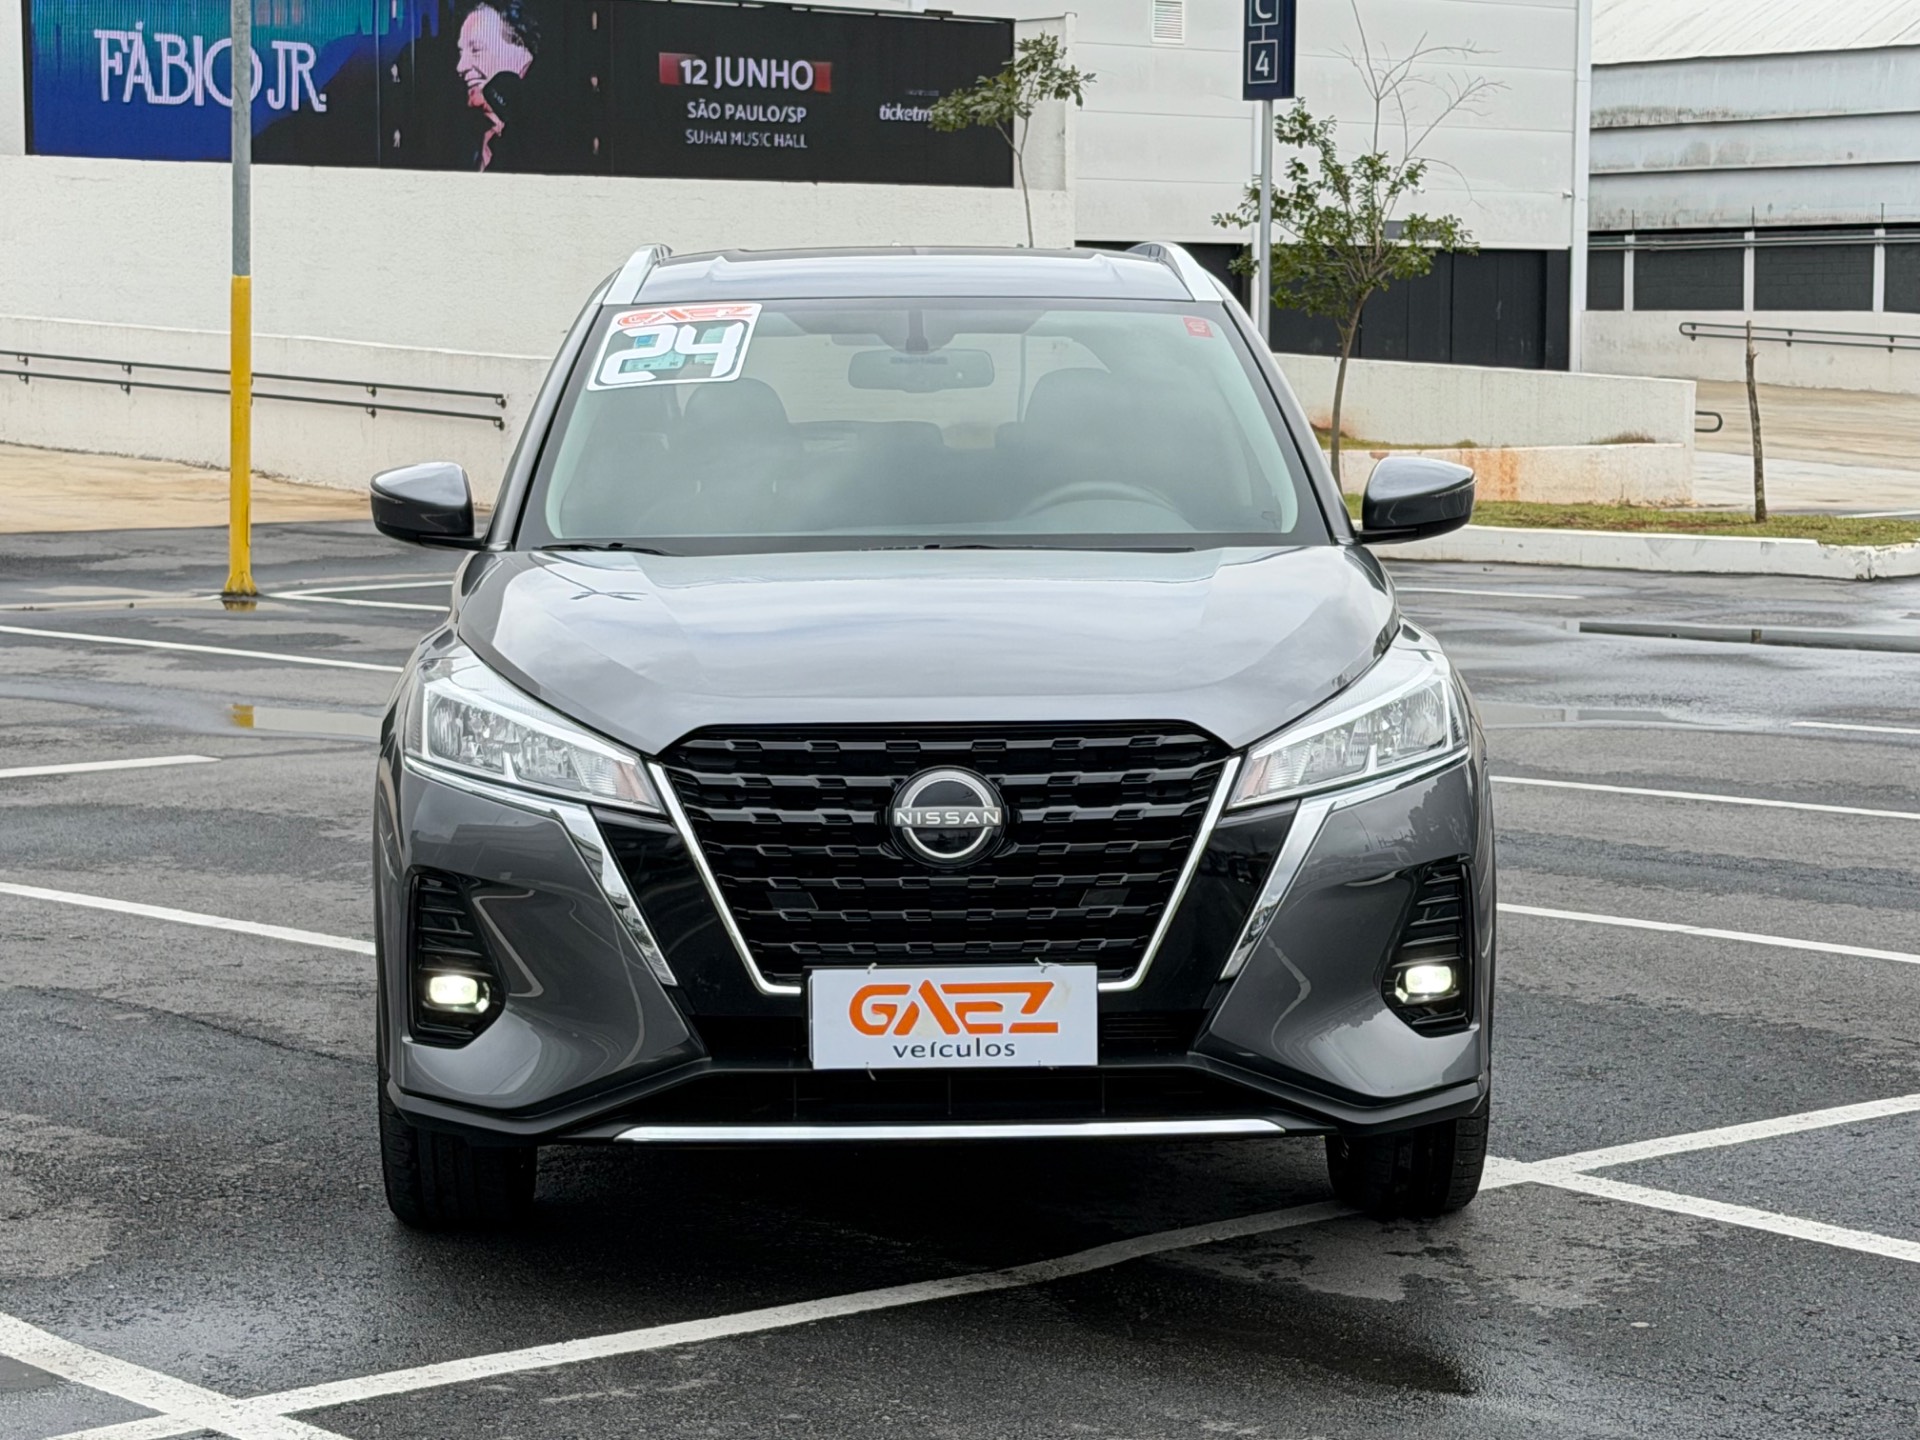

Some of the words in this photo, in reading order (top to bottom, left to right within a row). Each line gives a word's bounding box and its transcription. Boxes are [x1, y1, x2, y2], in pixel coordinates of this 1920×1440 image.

[1255, 0, 1272, 19] C
[94, 21, 263, 107] FÁBIO
[680, 59, 709, 85] 12
[714, 56, 813, 91] JUNHO
[1255, 50, 1269, 77] 4
[687, 98, 721, 119] SÃO
[725, 103, 807, 123] PAULO/SP
[879, 102, 933, 122] ticketm
[685, 129, 727, 145] SUHAI
[730, 131, 771, 147] MUSIC
[774, 133, 808, 148] HALL
[600, 321, 744, 384] 24
[896, 811, 1000, 825] NISSAN
[849, 979, 1059, 1036] GAEZ
[893, 1037, 1016, 1058] veículos
